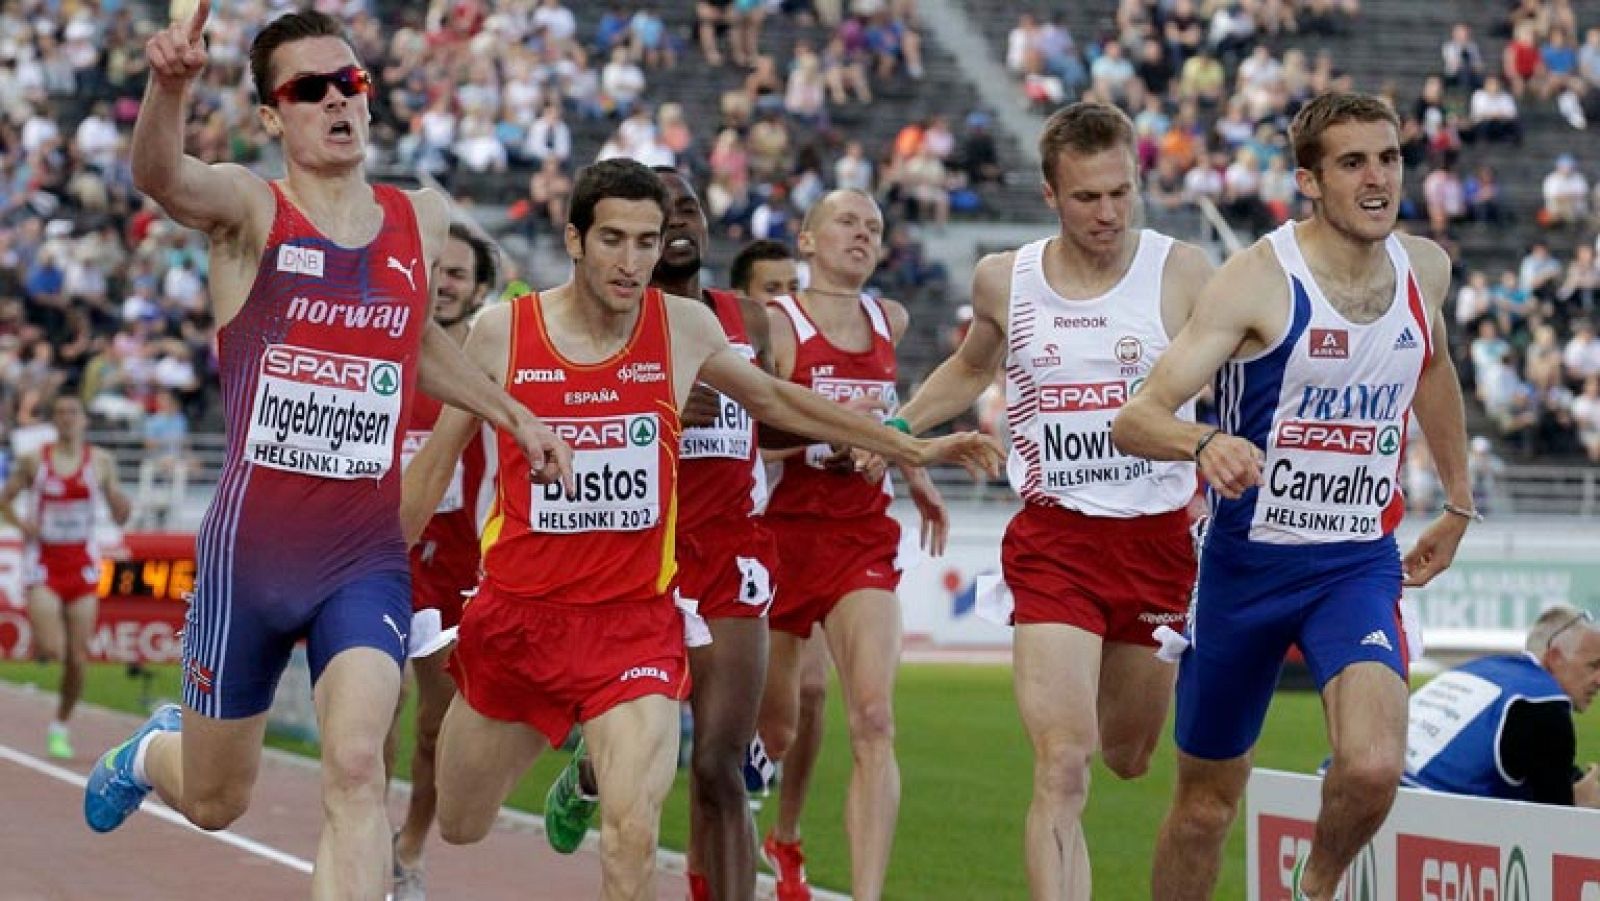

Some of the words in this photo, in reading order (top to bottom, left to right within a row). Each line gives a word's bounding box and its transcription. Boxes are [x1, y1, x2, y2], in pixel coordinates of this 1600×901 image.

[283, 250, 318, 270] DNB
[286, 297, 411, 337] norway
[1053, 316, 1108, 329] Reebok
[267, 350, 367, 387] SPAR
[811, 365, 835, 376] LAT
[563, 387, 620, 405] ESPAÑA
[1040, 385, 1125, 408] SPAR
[1296, 383, 1404, 421] FRANCE
[258, 383, 389, 450] Ingebrigtsen
[546, 423, 624, 446] PAR
[682, 437, 726, 455] SINKI
[1044, 421, 1127, 461] Nowi
[1280, 424, 1373, 450] SPAR
[253, 443, 338, 475] HELSINKI
[1048, 466, 1120, 487] HELSINKI
[1270, 459, 1391, 507] Carvalho
[538, 510, 616, 530] HELSINKI
[1265, 506, 1346, 533] HELSINKI
